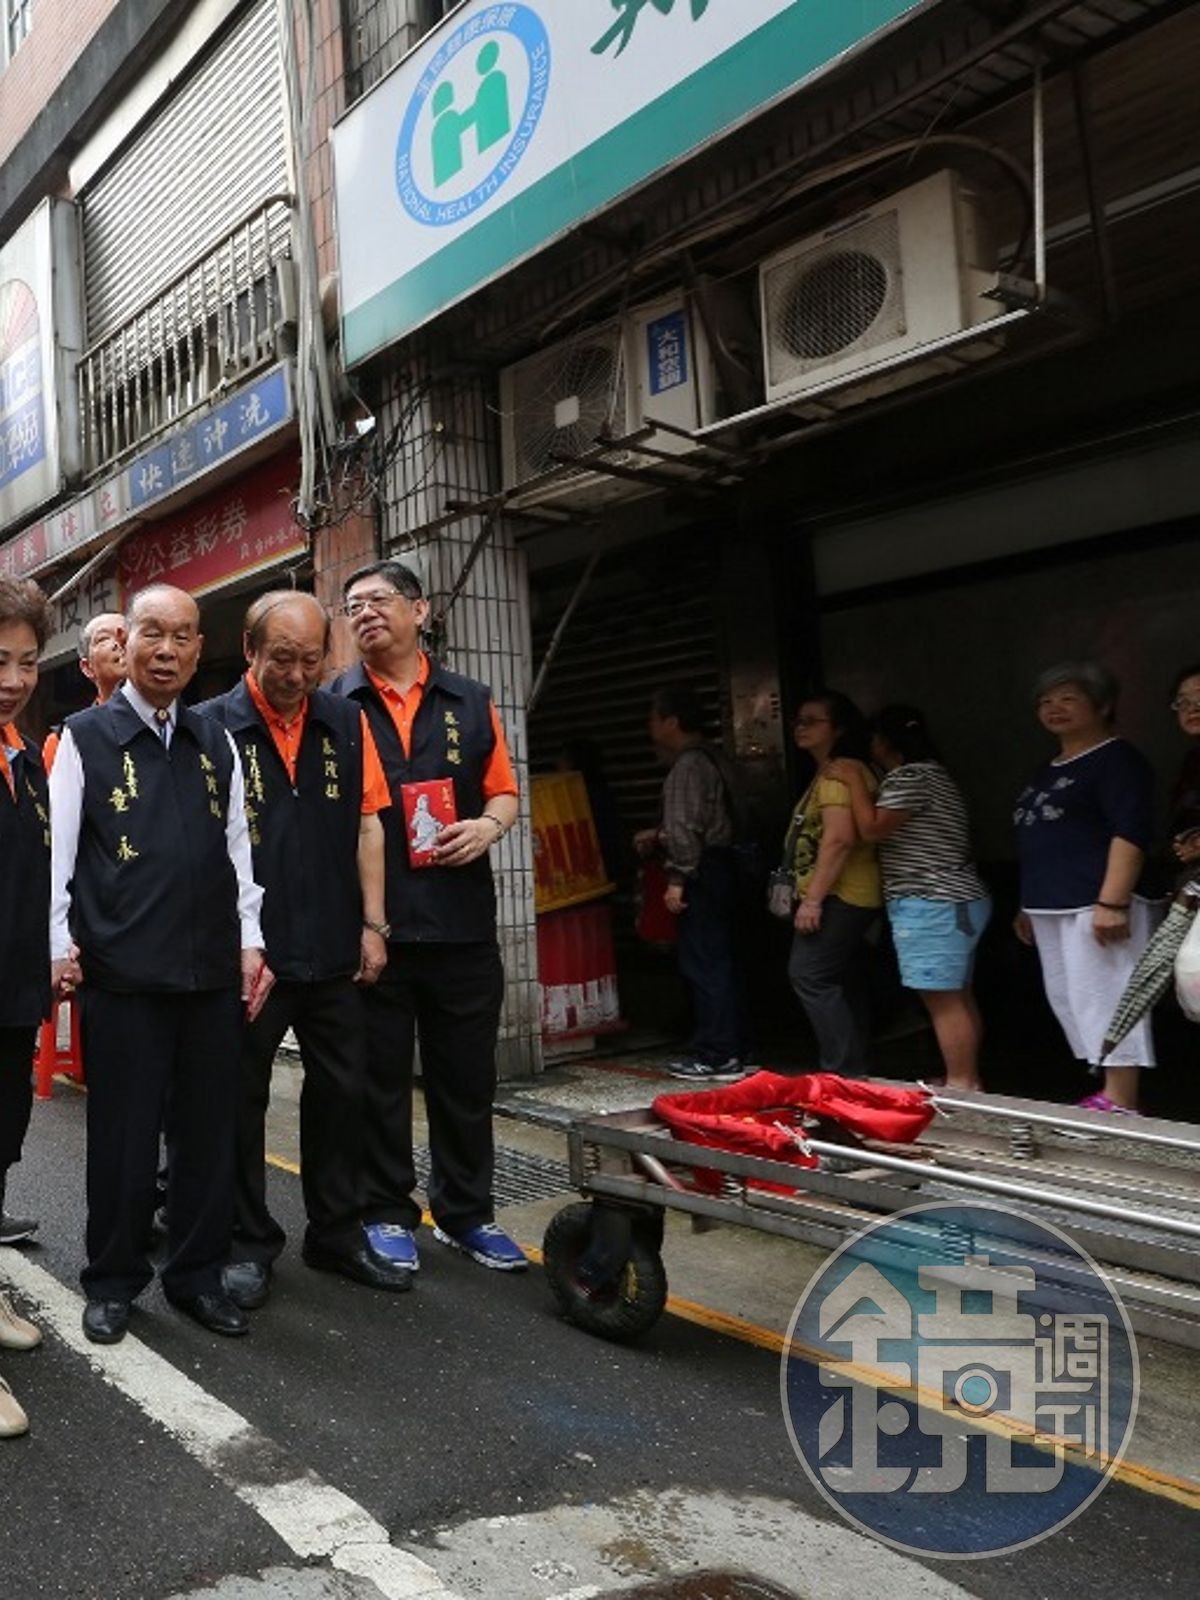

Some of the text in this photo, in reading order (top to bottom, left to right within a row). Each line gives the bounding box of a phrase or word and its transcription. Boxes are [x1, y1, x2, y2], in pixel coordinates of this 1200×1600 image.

[399, 38, 549, 223] NATIONAL HEALTH INSURANCE
[138, 395, 270, 496] 快速沖洗
[144, 498, 249, 581] 公益彩券
